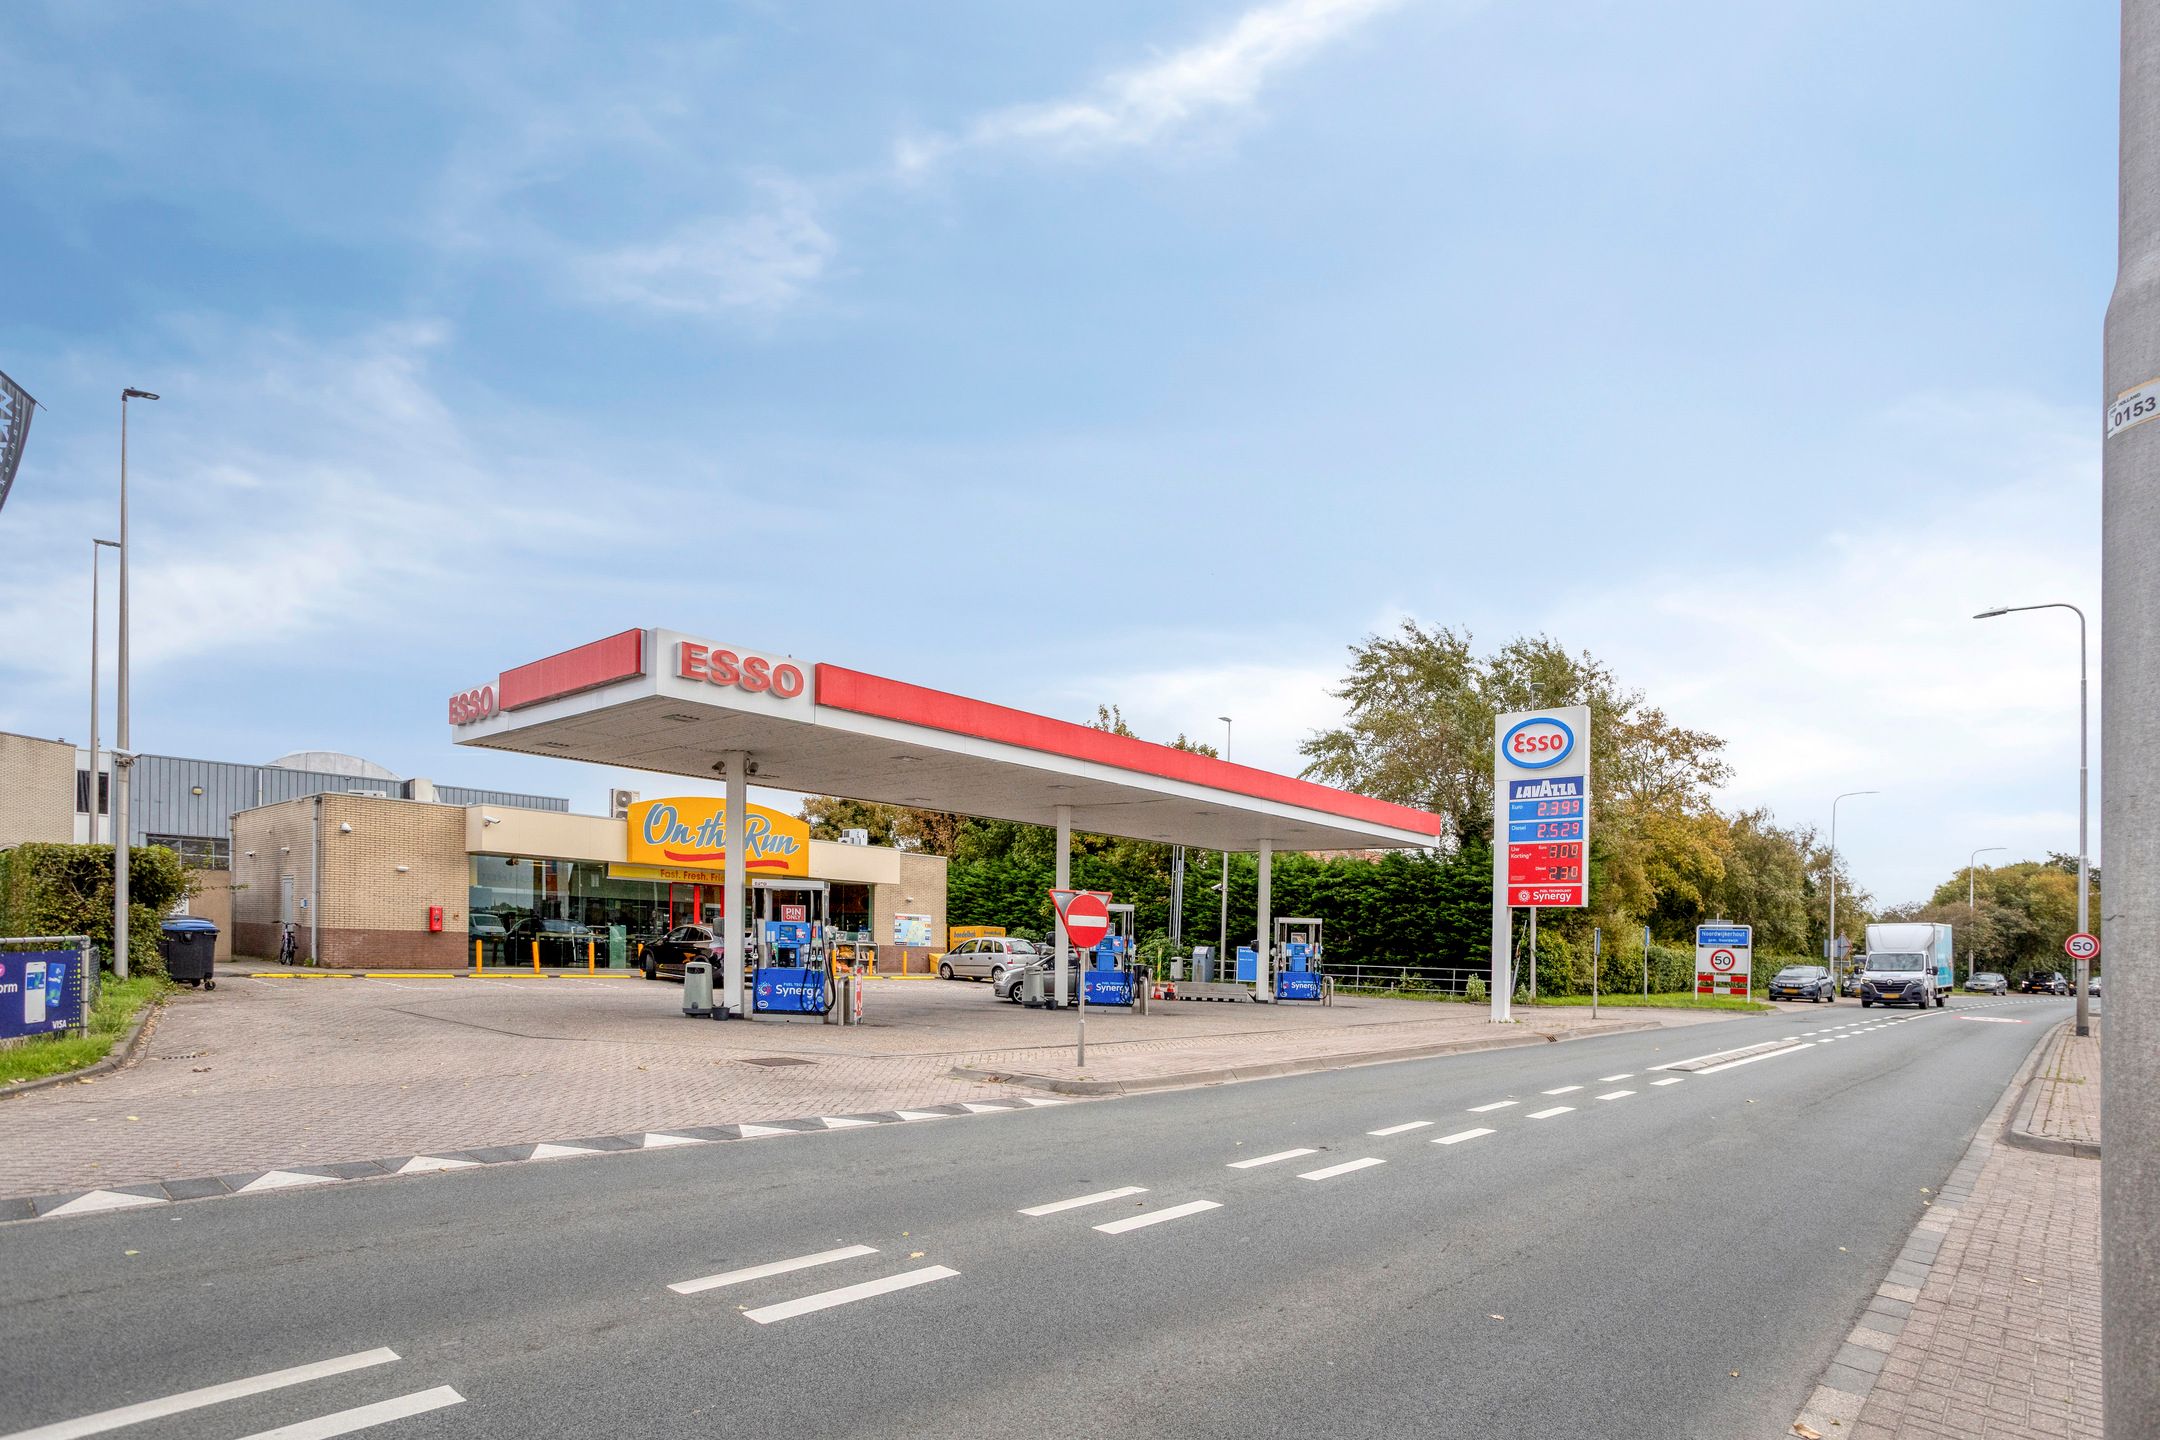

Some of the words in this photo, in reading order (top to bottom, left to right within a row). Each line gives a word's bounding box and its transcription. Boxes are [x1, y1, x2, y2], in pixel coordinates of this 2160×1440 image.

[2114, 396, 2157, 427] 0153
[679, 640, 805, 699] ESSO
[448, 686, 493, 725] ESSO
[1516, 780, 1577, 798] LAVAZZA
[1537, 800, 1580, 816] 2.399
[643, 802, 696, 845] On
[695, 810, 726, 848] th
[744, 813, 801, 858] Run
[1537, 822, 1579, 838] 2.529
[660, 869, 680, 879] Fast.
[684, 871, 708, 881] Fresh.
[1533, 891, 1572, 903] Synergy
[785, 907, 802, 915] PIN
[2072, 941, 2093, 951] 50
[1714, 955, 1731, 965] 50
[52, 1020, 67, 1029] VISA
